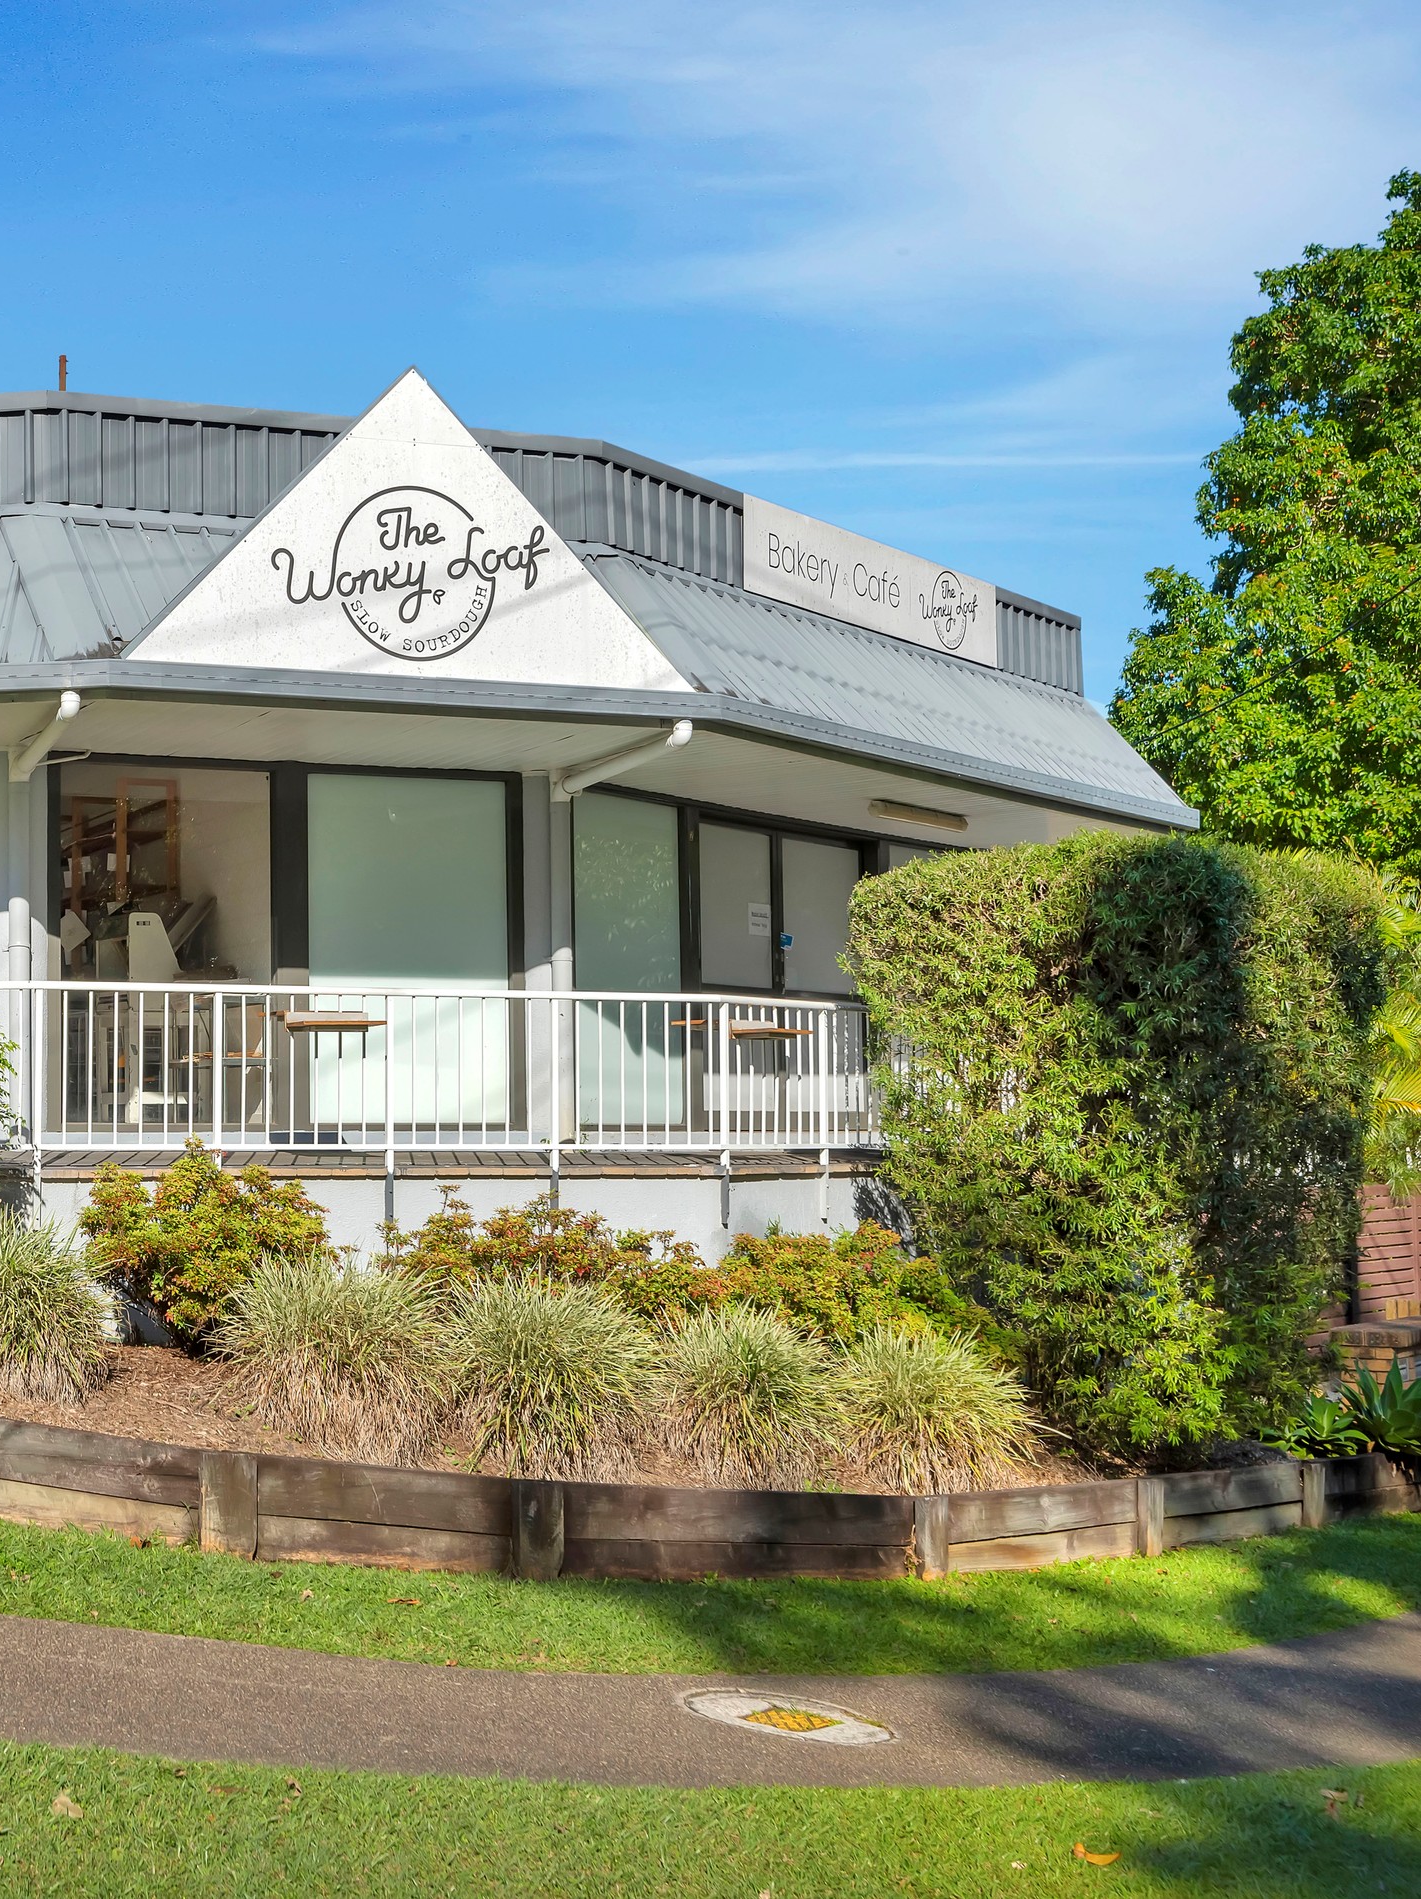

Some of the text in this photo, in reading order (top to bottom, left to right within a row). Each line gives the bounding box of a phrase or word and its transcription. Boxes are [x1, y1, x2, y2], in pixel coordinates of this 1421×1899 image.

[376, 506, 446, 551] The
[271, 525, 551, 624] Wonky Loaf
[767, 532, 839, 599] Bakery
[852, 563, 901, 609] Café
[941, 580, 956, 600] The
[349, 584, 488, 653] SLOW SOURDOUGH
[918, 593, 954, 633] Wonky
[956, 591, 978, 623] Loaf
